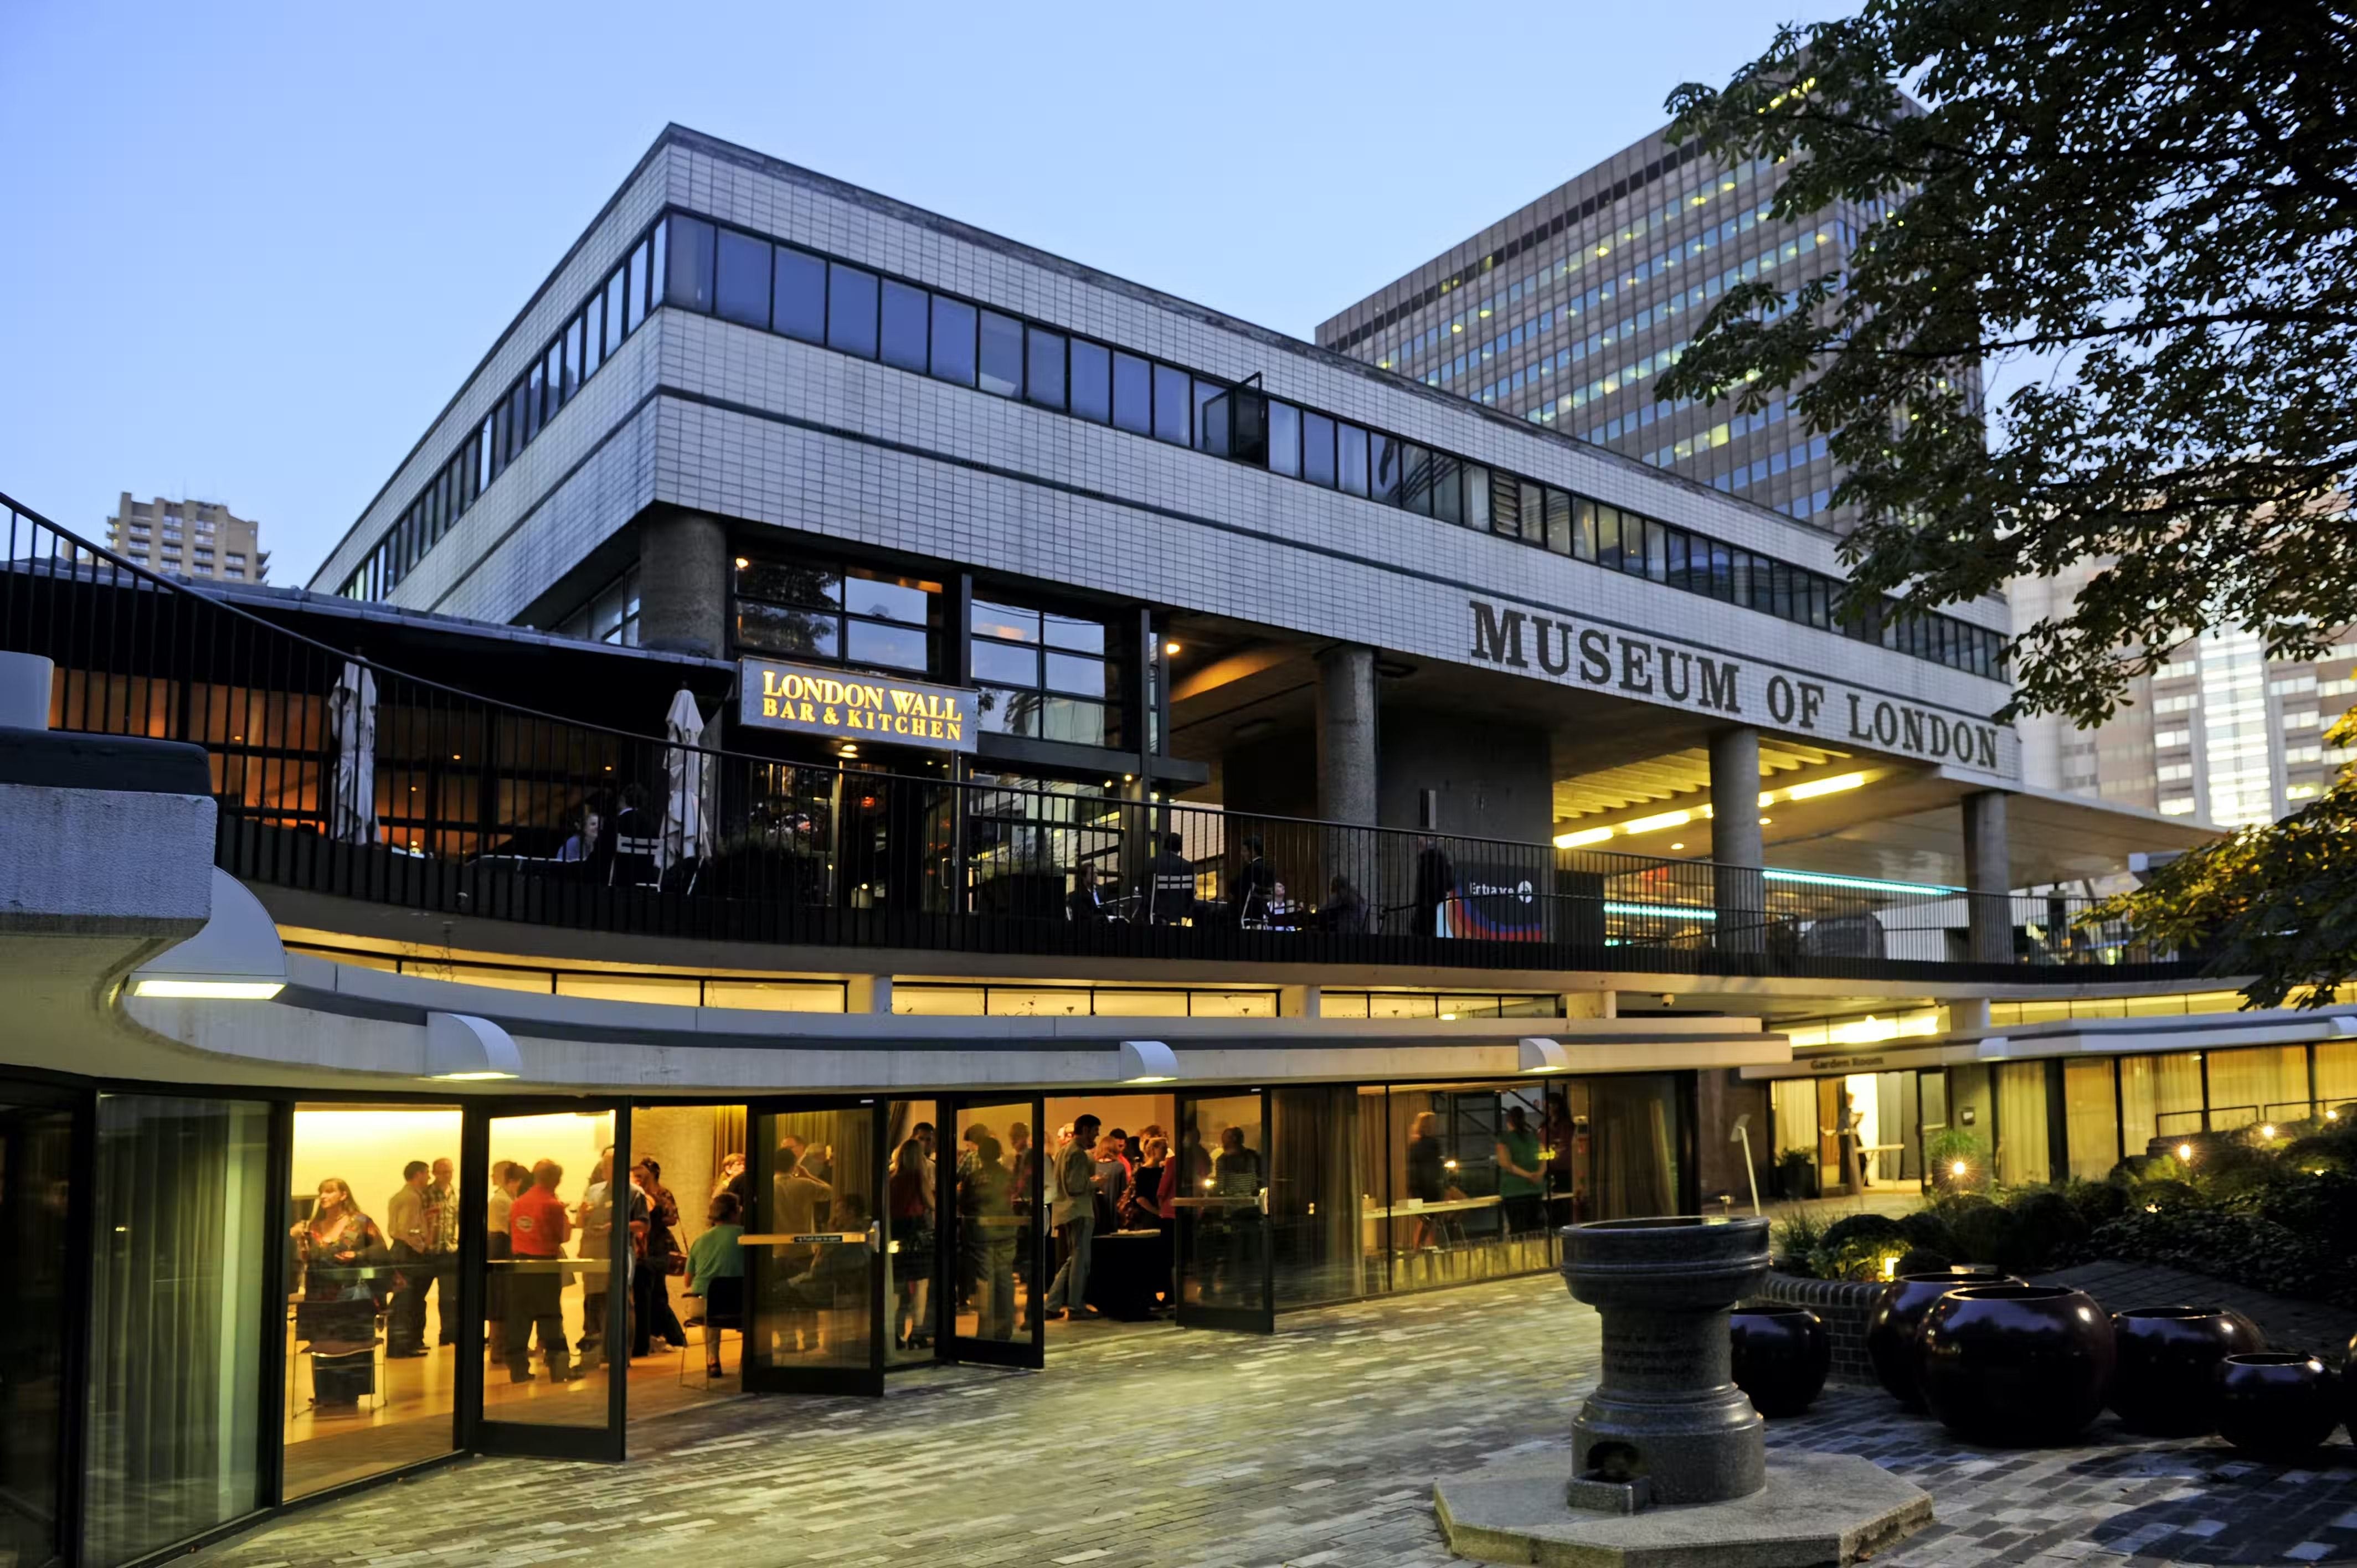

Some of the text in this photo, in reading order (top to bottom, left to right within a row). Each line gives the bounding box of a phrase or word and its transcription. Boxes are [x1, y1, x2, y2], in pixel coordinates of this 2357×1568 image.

[763, 670, 962, 721] LONDON WALL
[1469, 601, 1998, 768] MUSEUM OF LONDON
[763, 698, 961, 740] BAR & KITCHEN
